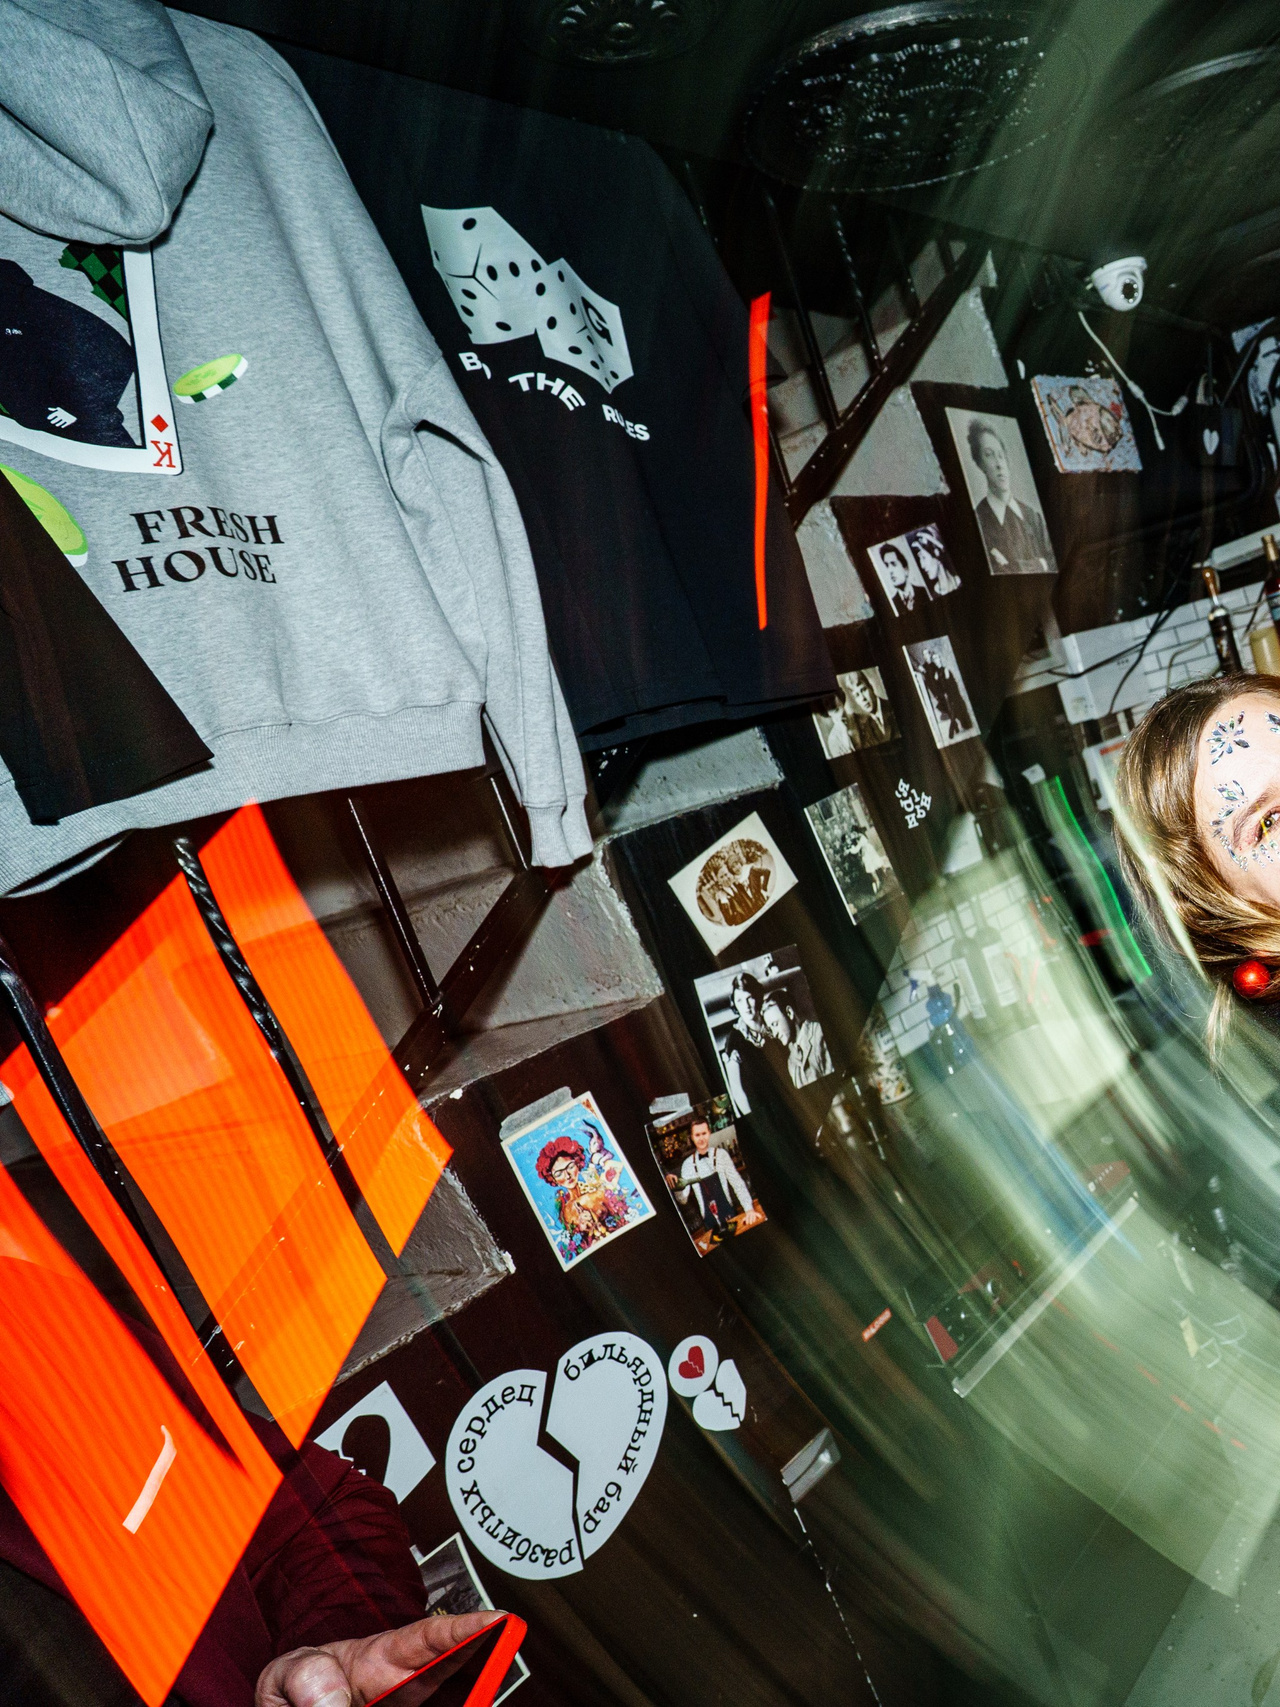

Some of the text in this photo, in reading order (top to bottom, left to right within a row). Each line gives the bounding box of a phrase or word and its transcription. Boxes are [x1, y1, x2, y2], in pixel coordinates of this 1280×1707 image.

[508, 372, 586, 411] THE
[601, 404, 651, 441] RUES
[150, 440, 177, 468] K
[130, 506, 285, 545] FRESH
[111, 547, 277, 592] HOUSE
[563, 1343, 655, 1534] бильярдный бар
[457, 1384, 577, 1568] разбитых сердец
